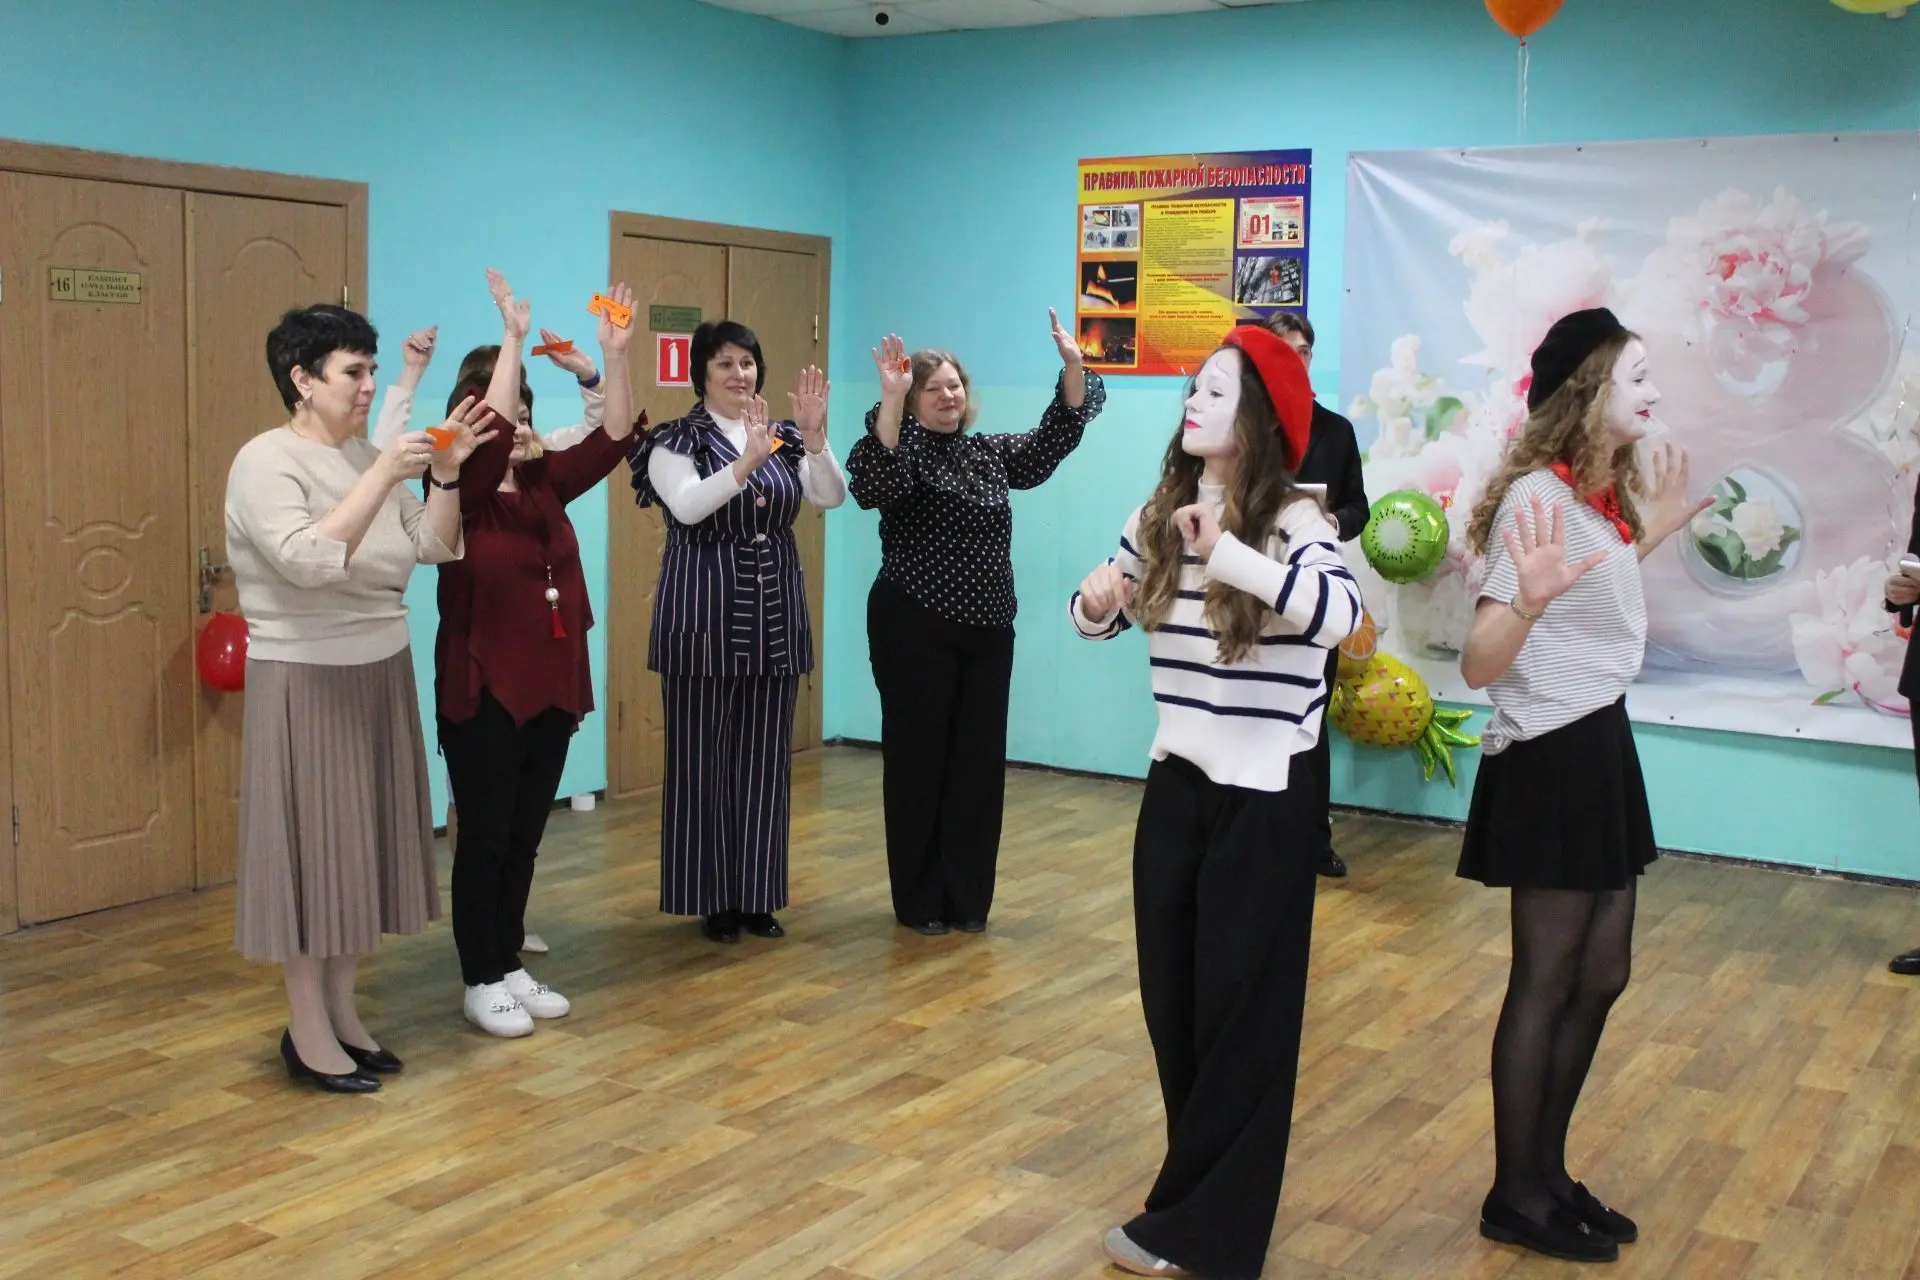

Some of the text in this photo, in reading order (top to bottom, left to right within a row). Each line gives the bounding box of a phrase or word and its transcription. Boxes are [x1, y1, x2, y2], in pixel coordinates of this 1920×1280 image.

[1084, 163, 1306, 191] ПРАВИЛА ПОЖАРНОЙ БЕЗОПАСНОСТИ
[1250, 214, 1270, 235] 01
[56, 276, 71, 293] 16
[88, 275, 128, 283] КАБИНЕТ
